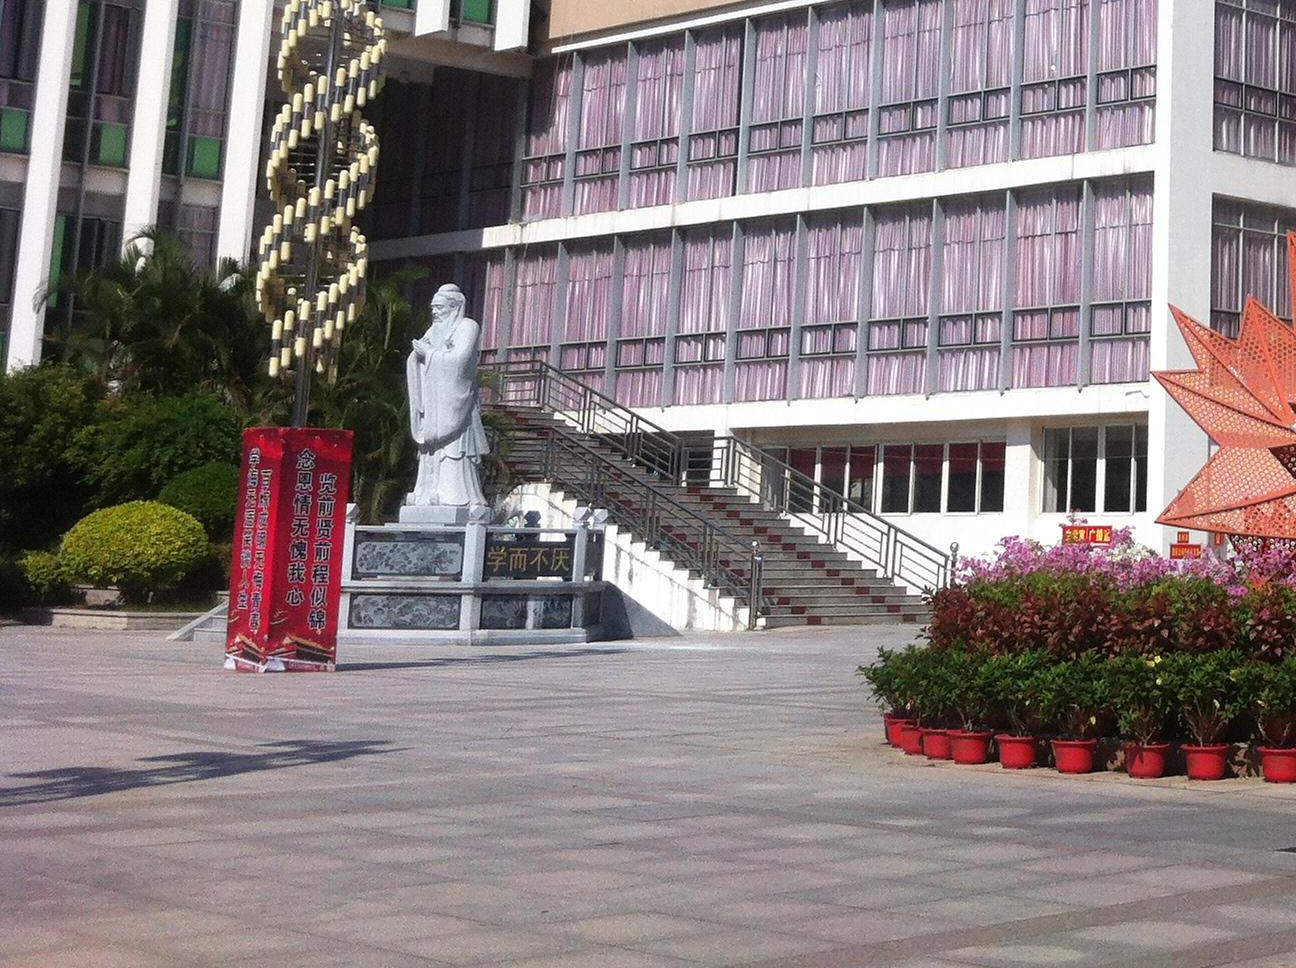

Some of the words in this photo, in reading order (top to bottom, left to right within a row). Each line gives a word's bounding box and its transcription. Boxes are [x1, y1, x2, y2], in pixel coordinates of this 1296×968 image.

[286, 448, 316, 607] 念恩情无愧我心
[307, 473, 338, 631] 览前贤前程似锦
[487, 546, 570, 572] 学而不厌
